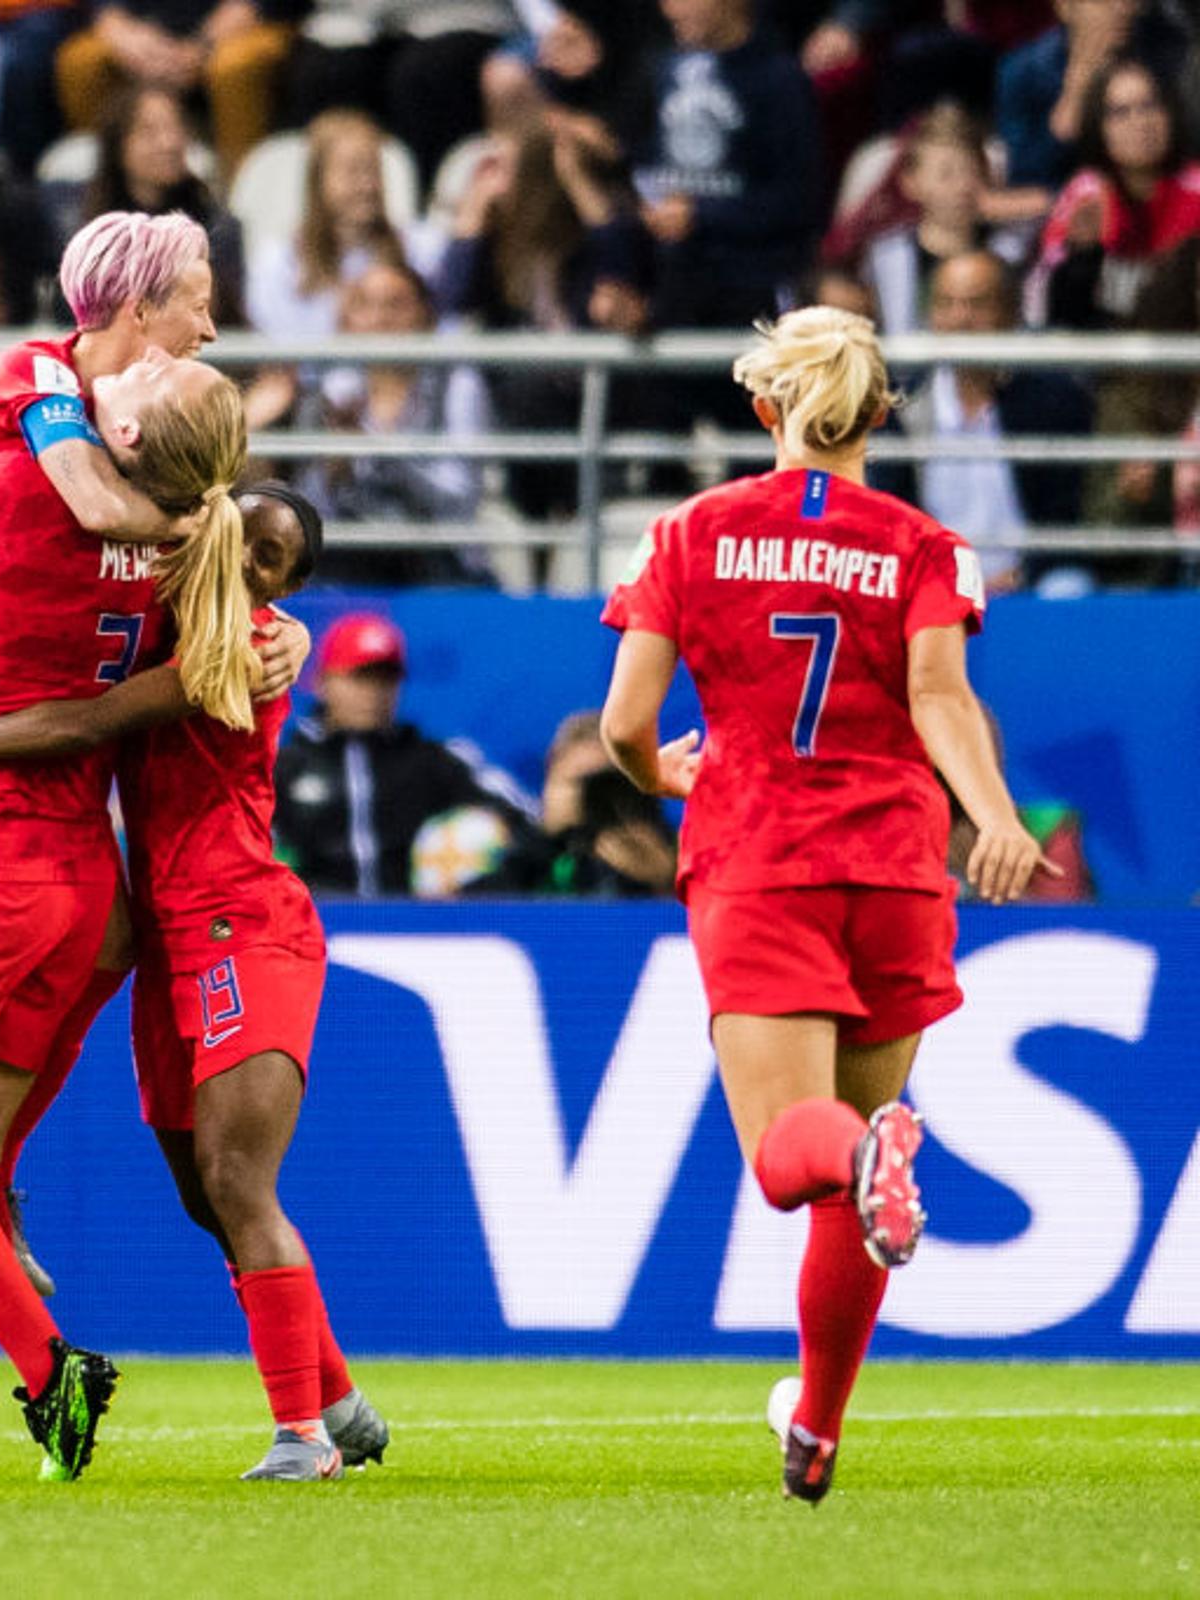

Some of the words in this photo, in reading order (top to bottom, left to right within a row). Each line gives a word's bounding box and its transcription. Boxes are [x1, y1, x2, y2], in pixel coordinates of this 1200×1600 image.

[715, 535, 898, 599] DAHLKEMPER
[769, 611, 840, 758] 7
[196, 955, 245, 1030] 19
